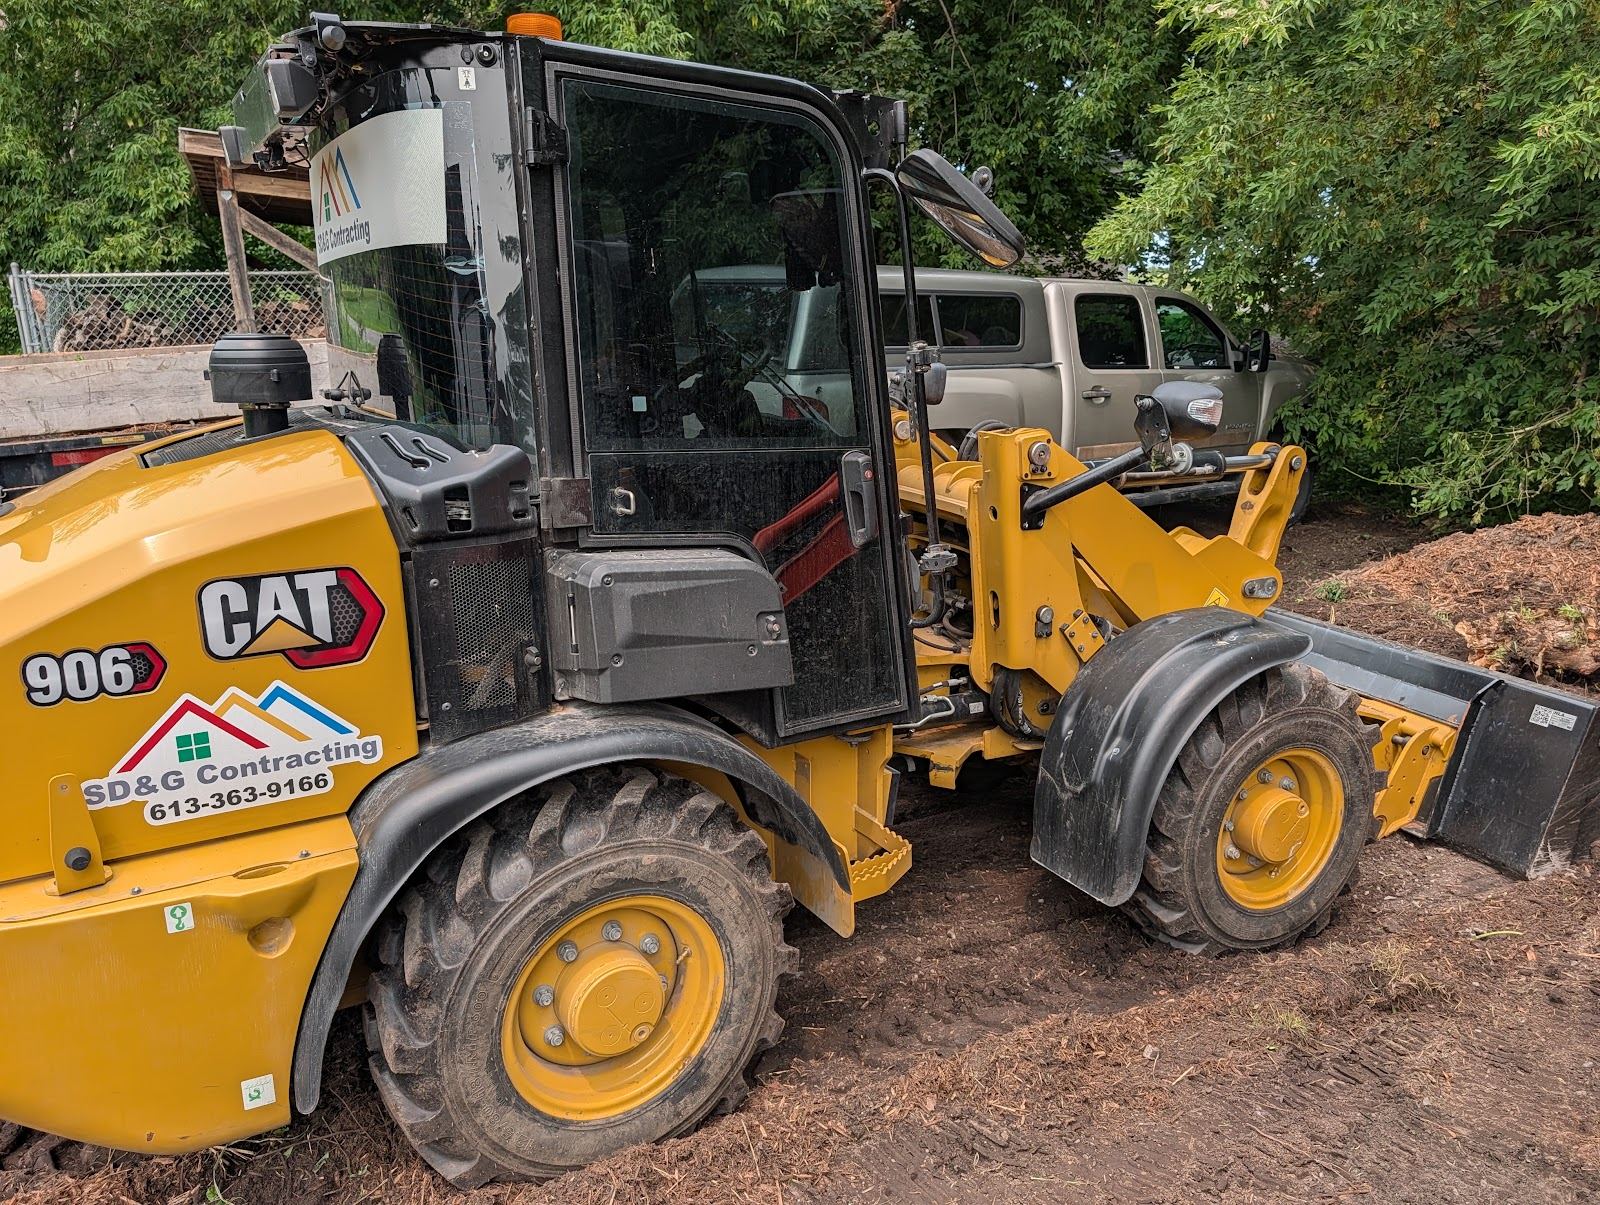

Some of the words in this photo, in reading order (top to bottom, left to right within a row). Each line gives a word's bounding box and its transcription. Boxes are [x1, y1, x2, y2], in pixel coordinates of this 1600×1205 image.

[330, 218, 371, 250] Contracting
[201, 570, 338, 658] CAT
[25, 647, 136, 705] 906
[84, 770, 185, 806] SD&G
[197, 738, 379, 785] Contracting
[150, 772, 329, 821] 613-363-9166
